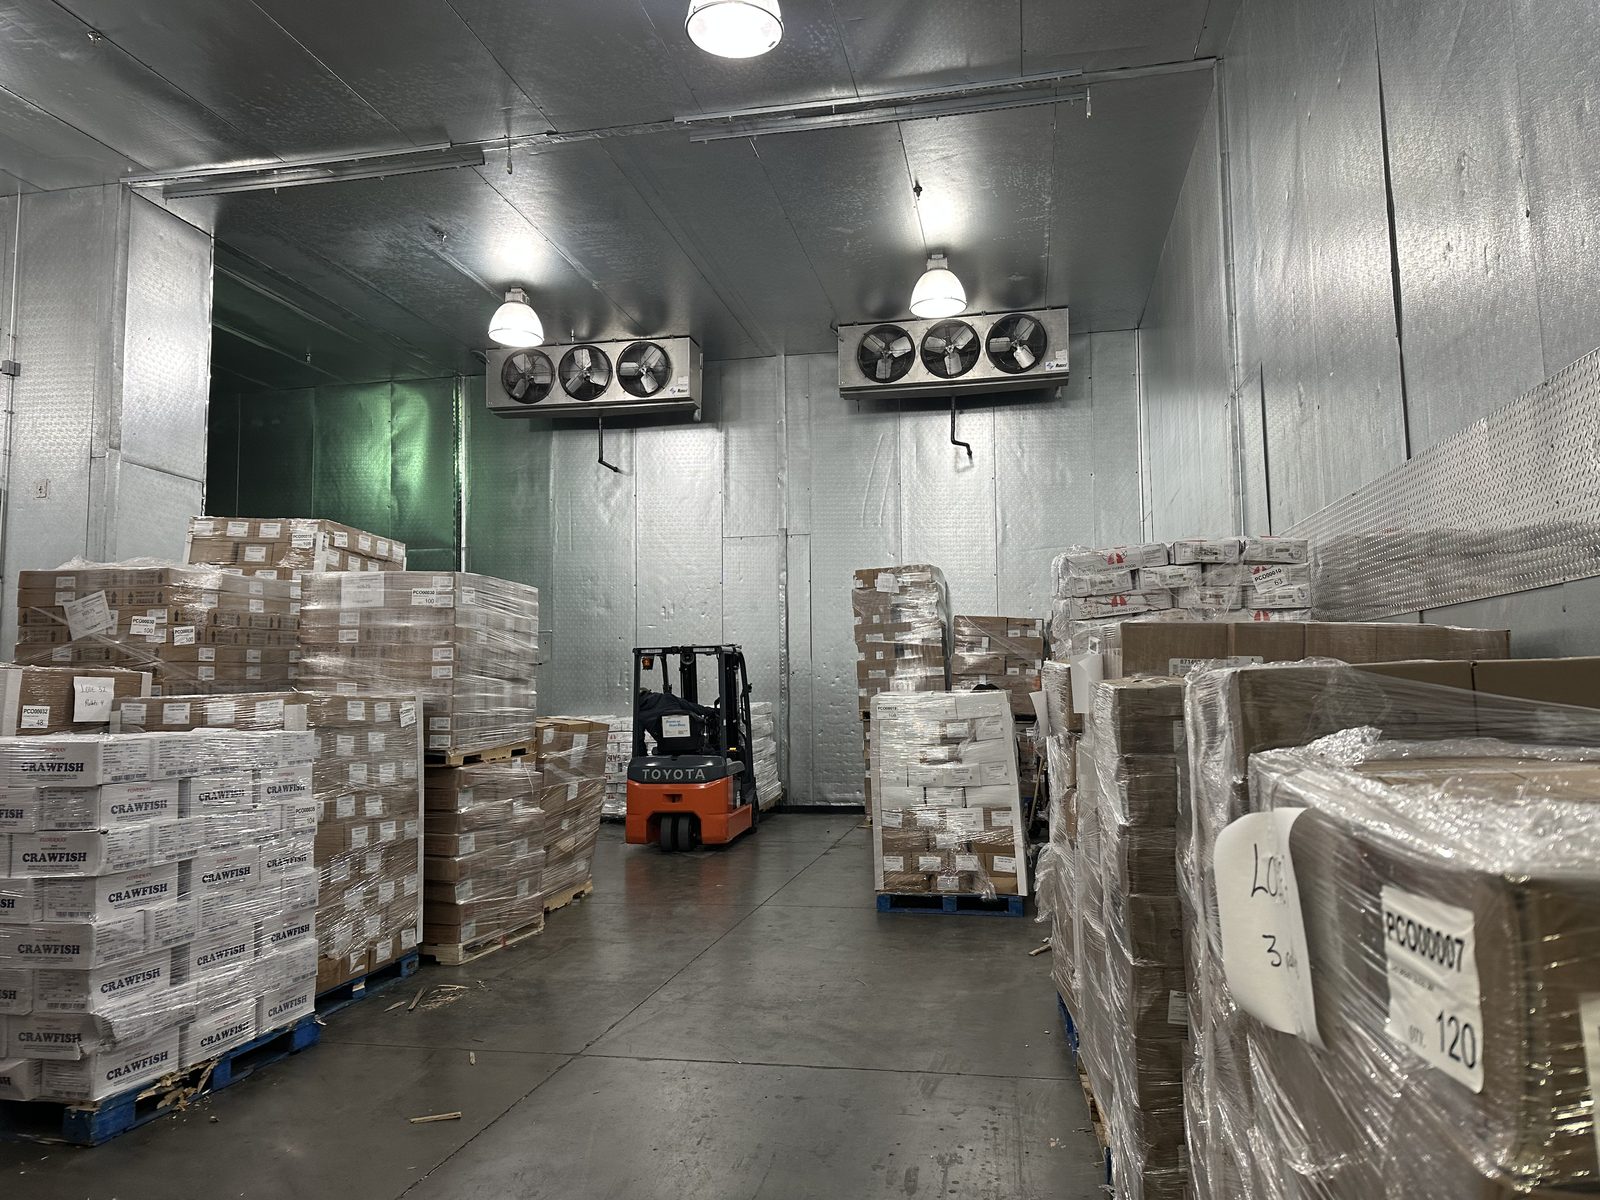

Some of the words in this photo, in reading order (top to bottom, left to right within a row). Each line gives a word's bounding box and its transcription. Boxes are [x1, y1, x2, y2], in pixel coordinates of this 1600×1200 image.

[1254, 568, 1282, 582] PCO00010
[21, 762, 84, 772] CRAWFISH
[642, 769, 706, 780] TOYOTA
[266, 784, 306, 794] CRAWFISH
[111, 800, 168, 814] CRAWFISH
[22, 852, 87, 862] CRAWFISH
[267, 854, 307, 868] CRAWFISH
[202, 866, 251, 884] CRAWFISH
[108, 883, 168, 903] CRAWFISH
[270, 924, 310, 942] CRAWFISH
[1386, 912, 1464, 972] PCO00007
[18, 944, 80, 954] CRAWFISH
[197, 944, 246, 966] CRAWFISH
[1262, 934, 1282, 967] 3
[100, 968, 161, 994] CRAWFISH
[268, 995, 308, 1018] CRAWFISH
[18, 1032, 82, 1043] CRAWFISH
[200, 1021, 250, 1047] CRAWFISH
[1436, 1010, 1476, 1069] 120
[106, 1050, 168, 1081] CRAWFISH
